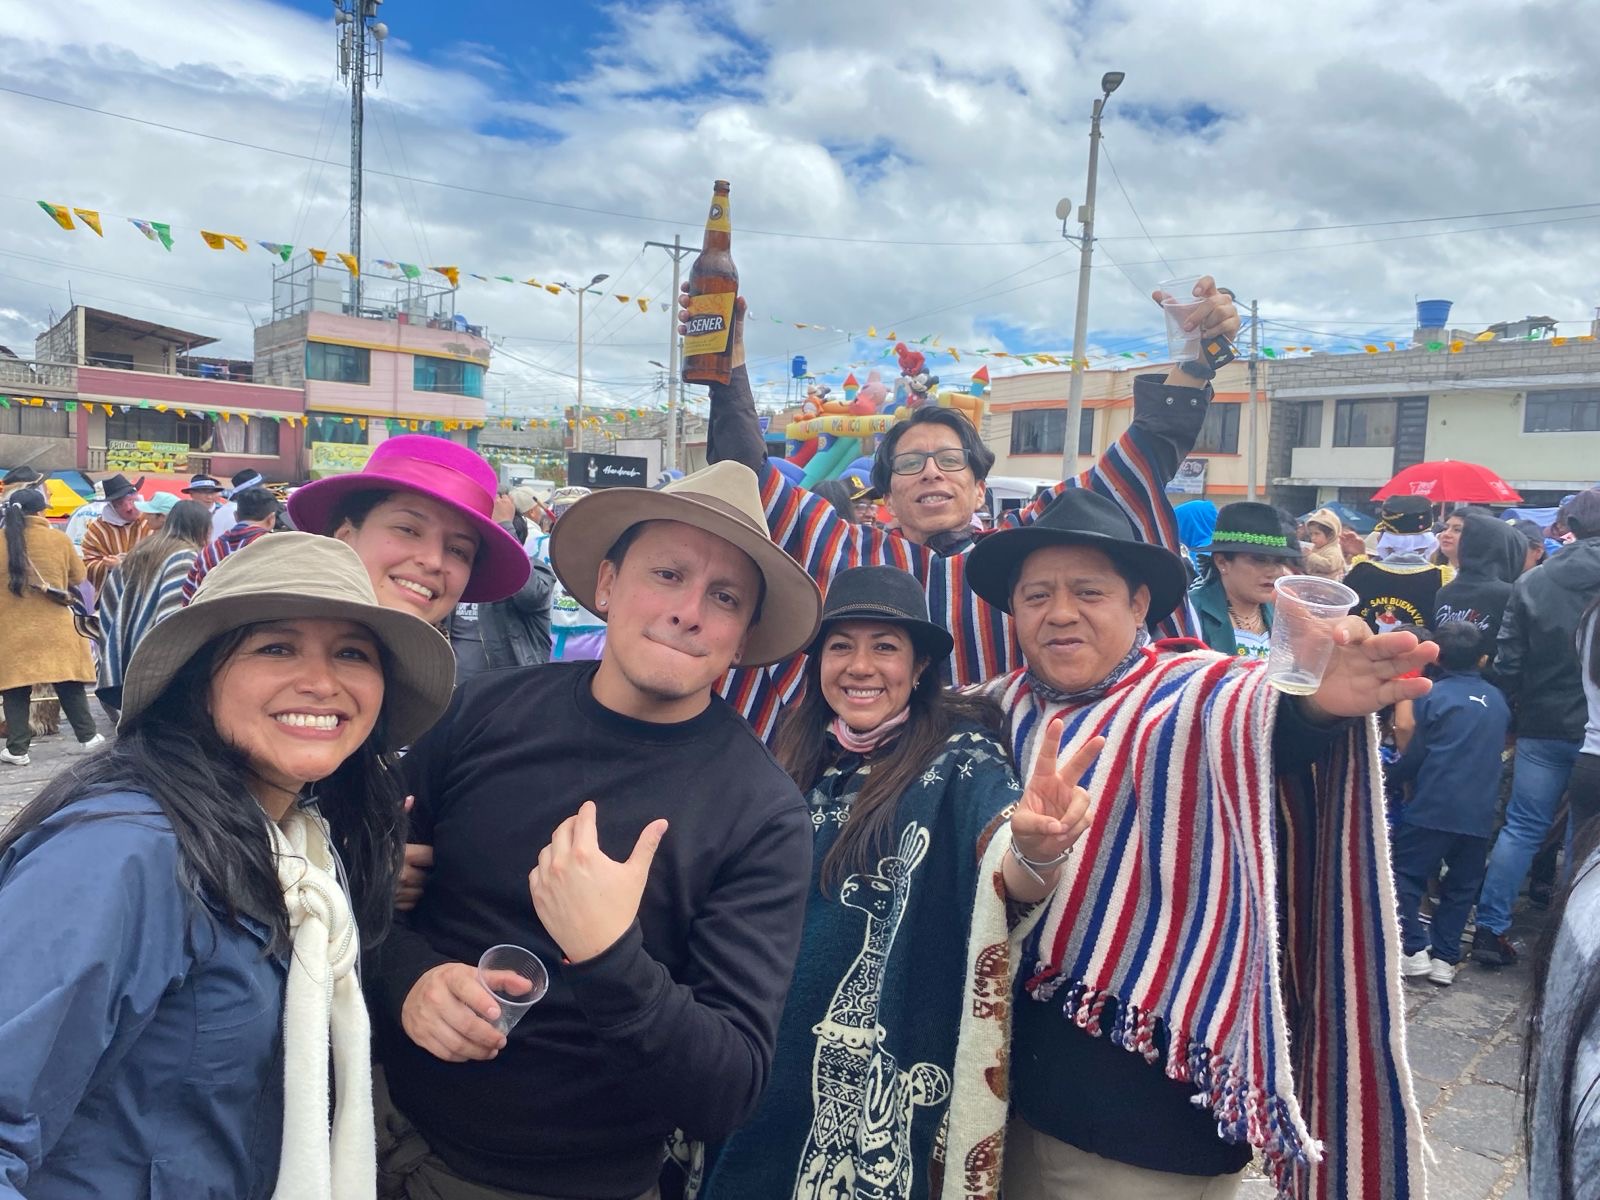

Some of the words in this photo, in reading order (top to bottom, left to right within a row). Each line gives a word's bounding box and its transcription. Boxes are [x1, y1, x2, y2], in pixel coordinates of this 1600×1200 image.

[686, 316, 723, 333] ILSENER
[1370, 597, 1388, 607] SAN
[1389, 597, 1425, 627] BUENAVE
